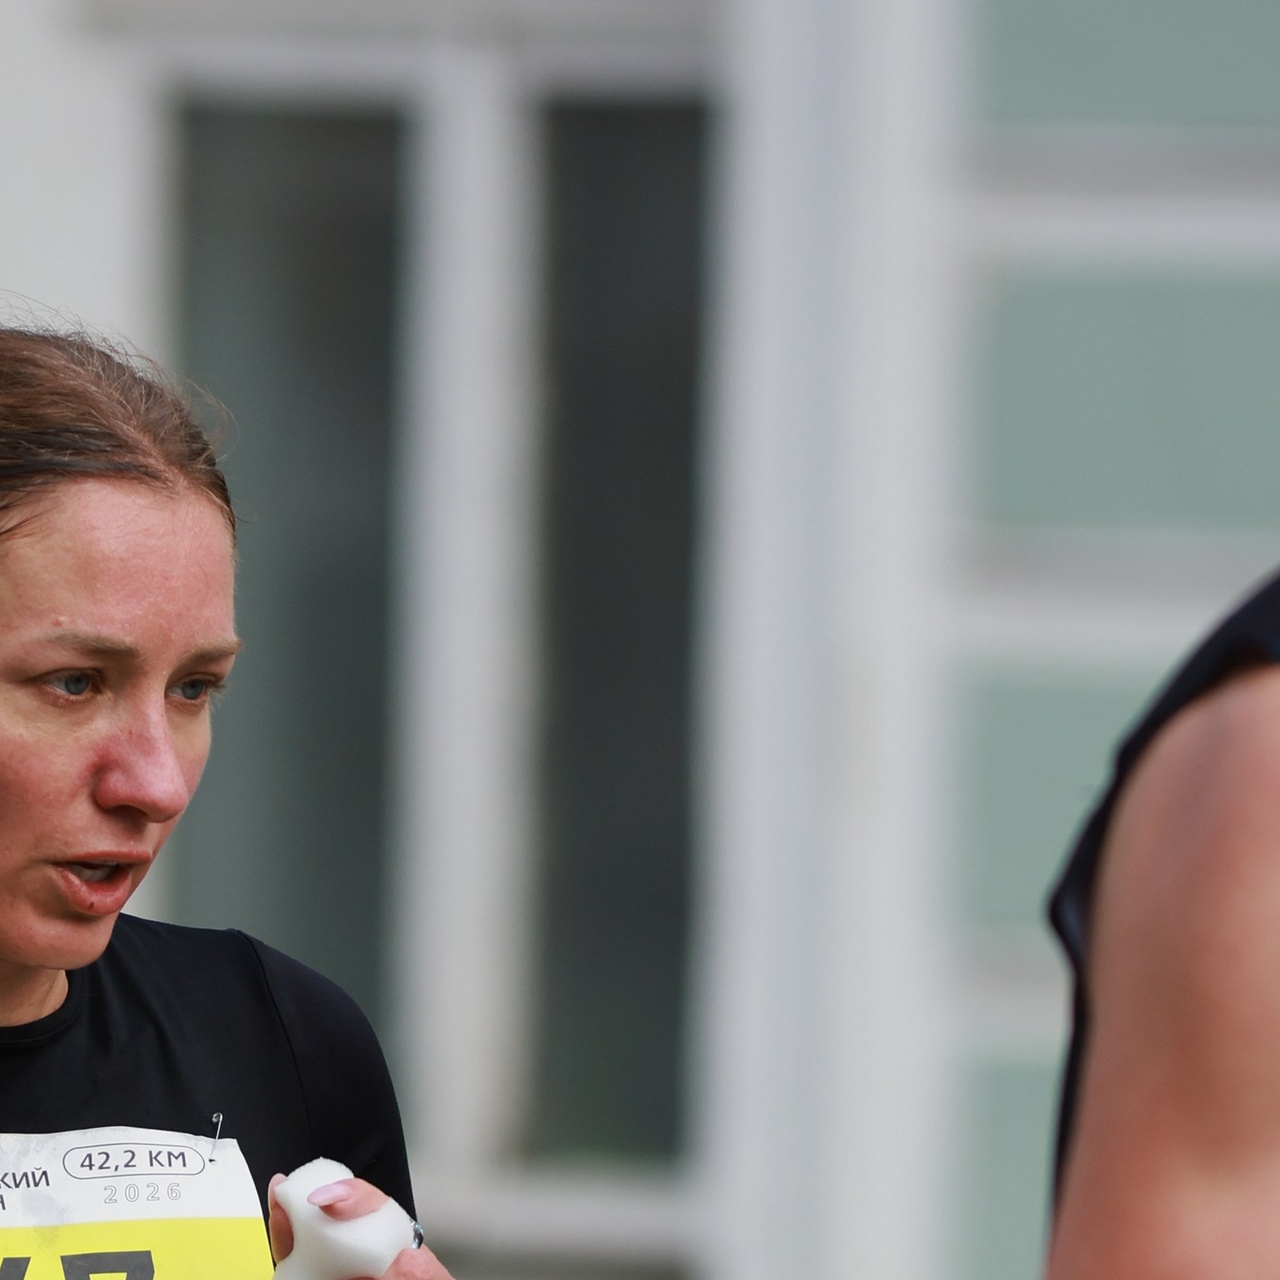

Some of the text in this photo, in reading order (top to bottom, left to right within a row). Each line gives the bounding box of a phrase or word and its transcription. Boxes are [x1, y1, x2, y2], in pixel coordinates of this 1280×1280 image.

[80, 1149, 187, 1172] 42,2 КМ
[104, 1182, 181, 1204] 2026
